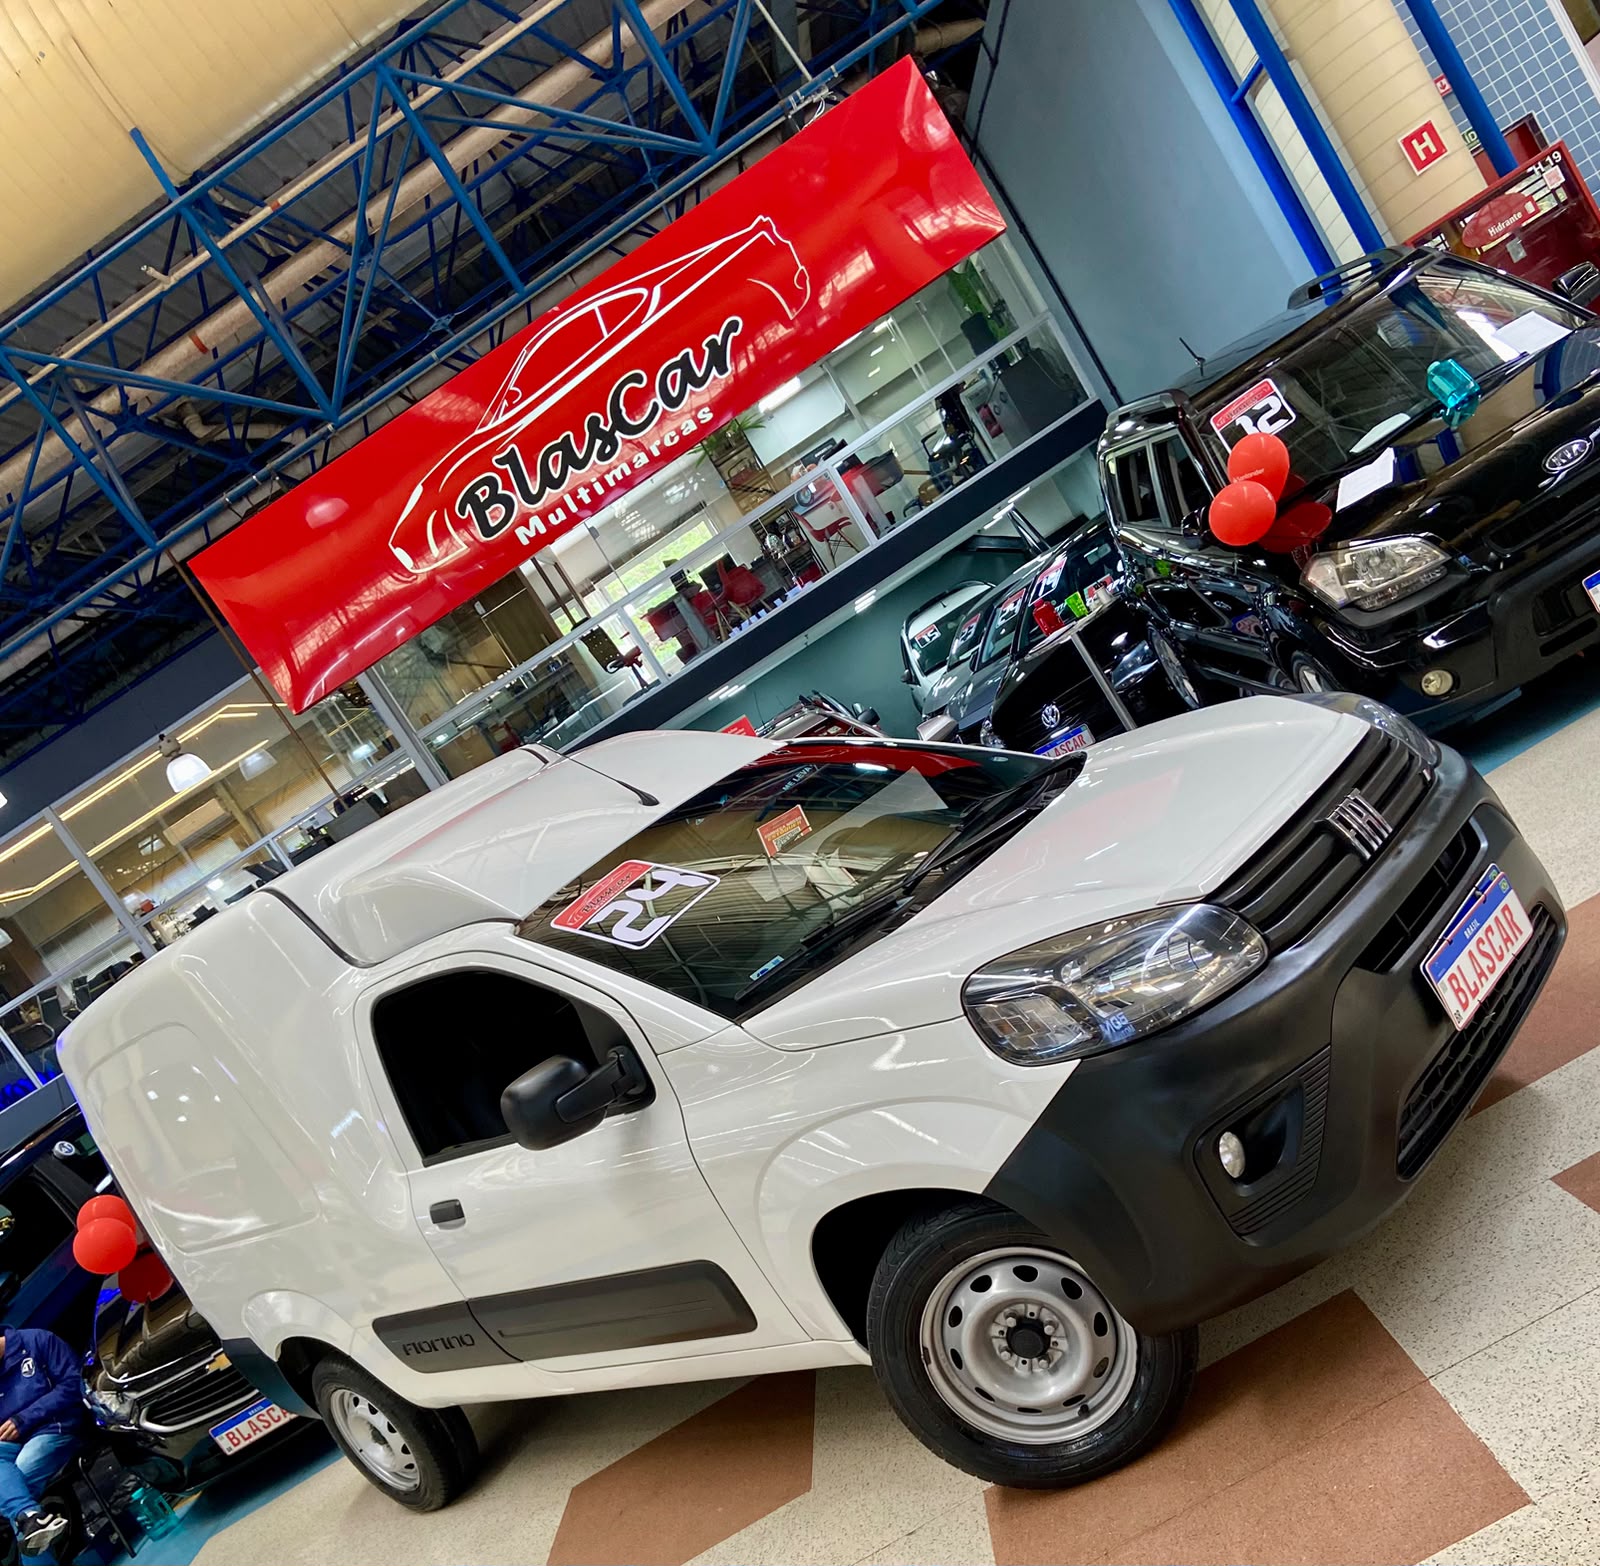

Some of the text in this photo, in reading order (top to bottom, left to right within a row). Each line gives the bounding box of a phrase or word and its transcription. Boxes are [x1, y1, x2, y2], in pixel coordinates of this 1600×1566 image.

[1411, 131, 1437, 161] H
[1532, 150, 1562, 175] H 19
[1487, 211, 1523, 237] Hidrante
[456, 316, 743, 540] BlasCar
[514, 406, 713, 545] Multimarcas
[792, 766, 812, 782] LEVA
[1326, 788, 1393, 860] FIAT
[1447, 903, 1524, 1012] BLASCAR
